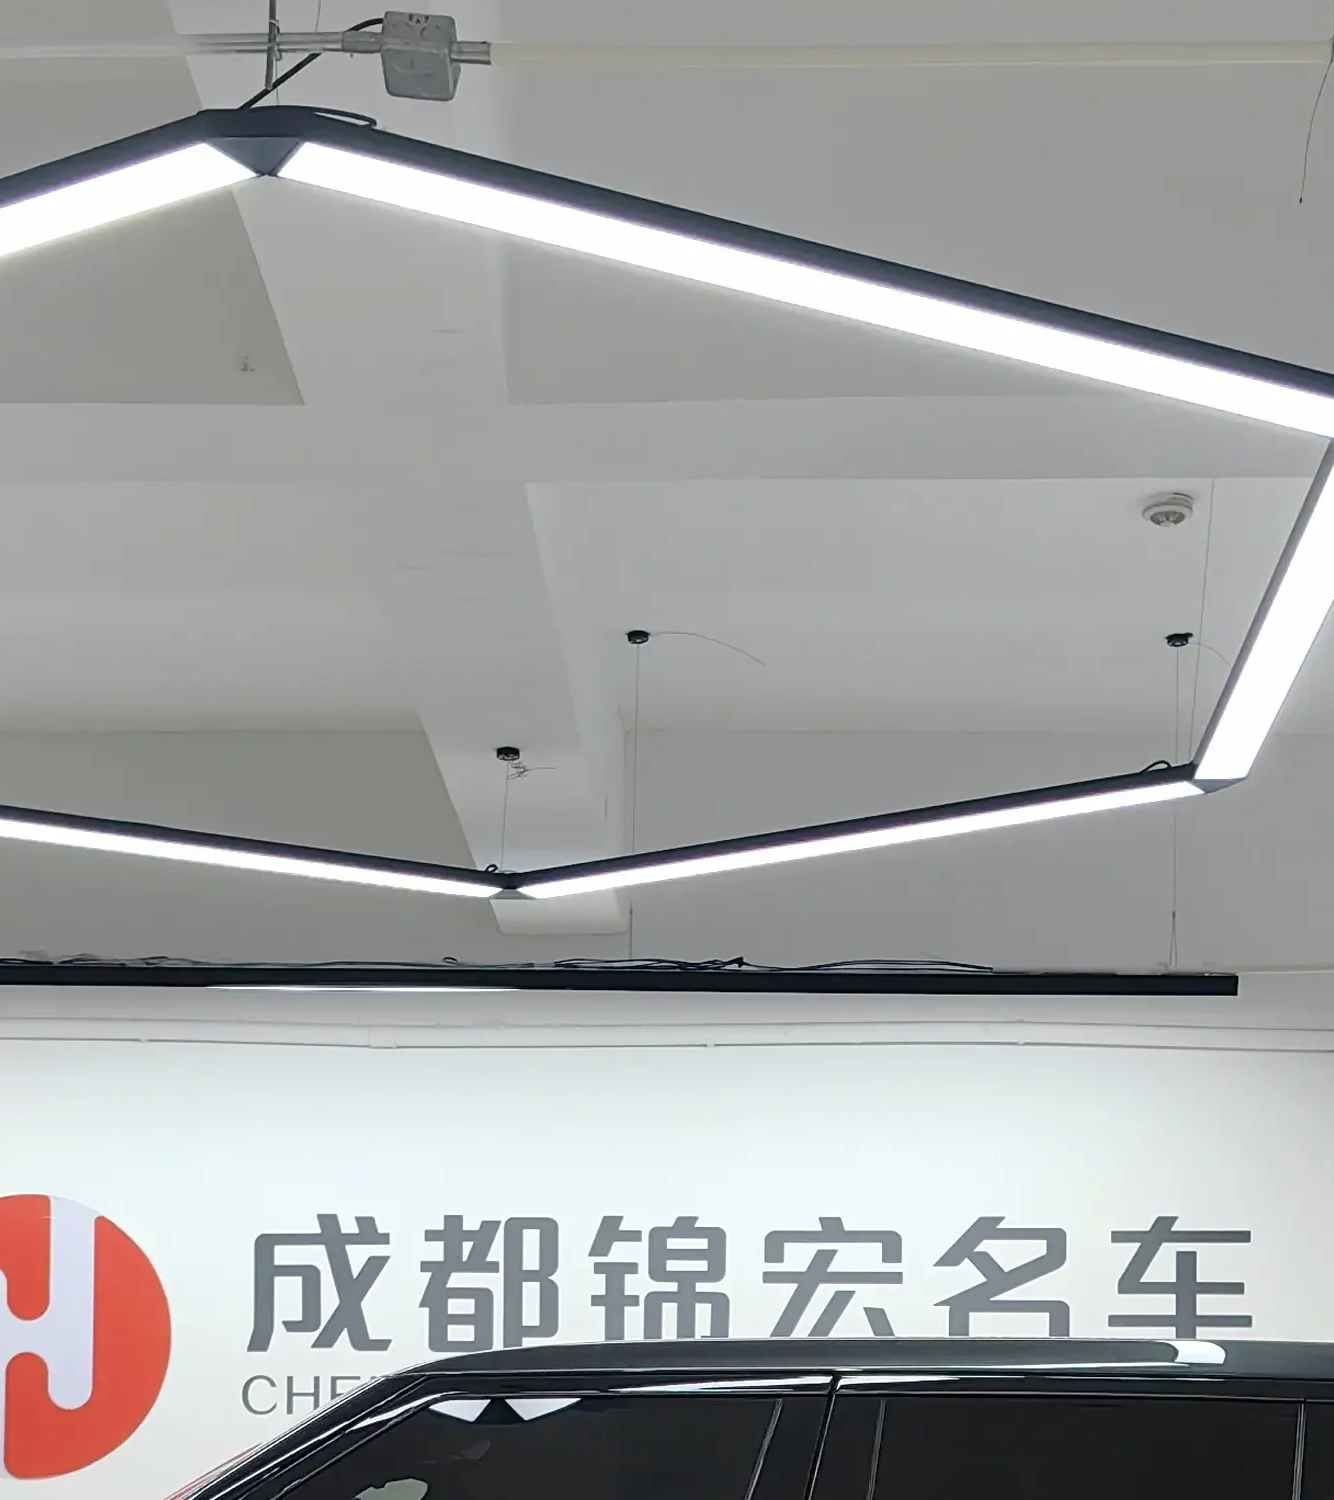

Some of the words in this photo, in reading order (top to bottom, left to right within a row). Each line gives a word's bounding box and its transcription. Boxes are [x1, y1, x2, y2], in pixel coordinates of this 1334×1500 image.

[246, 1213, 1253, 1353] 成都锦宏名车
[241, 1374, 385, 1416] CHE
